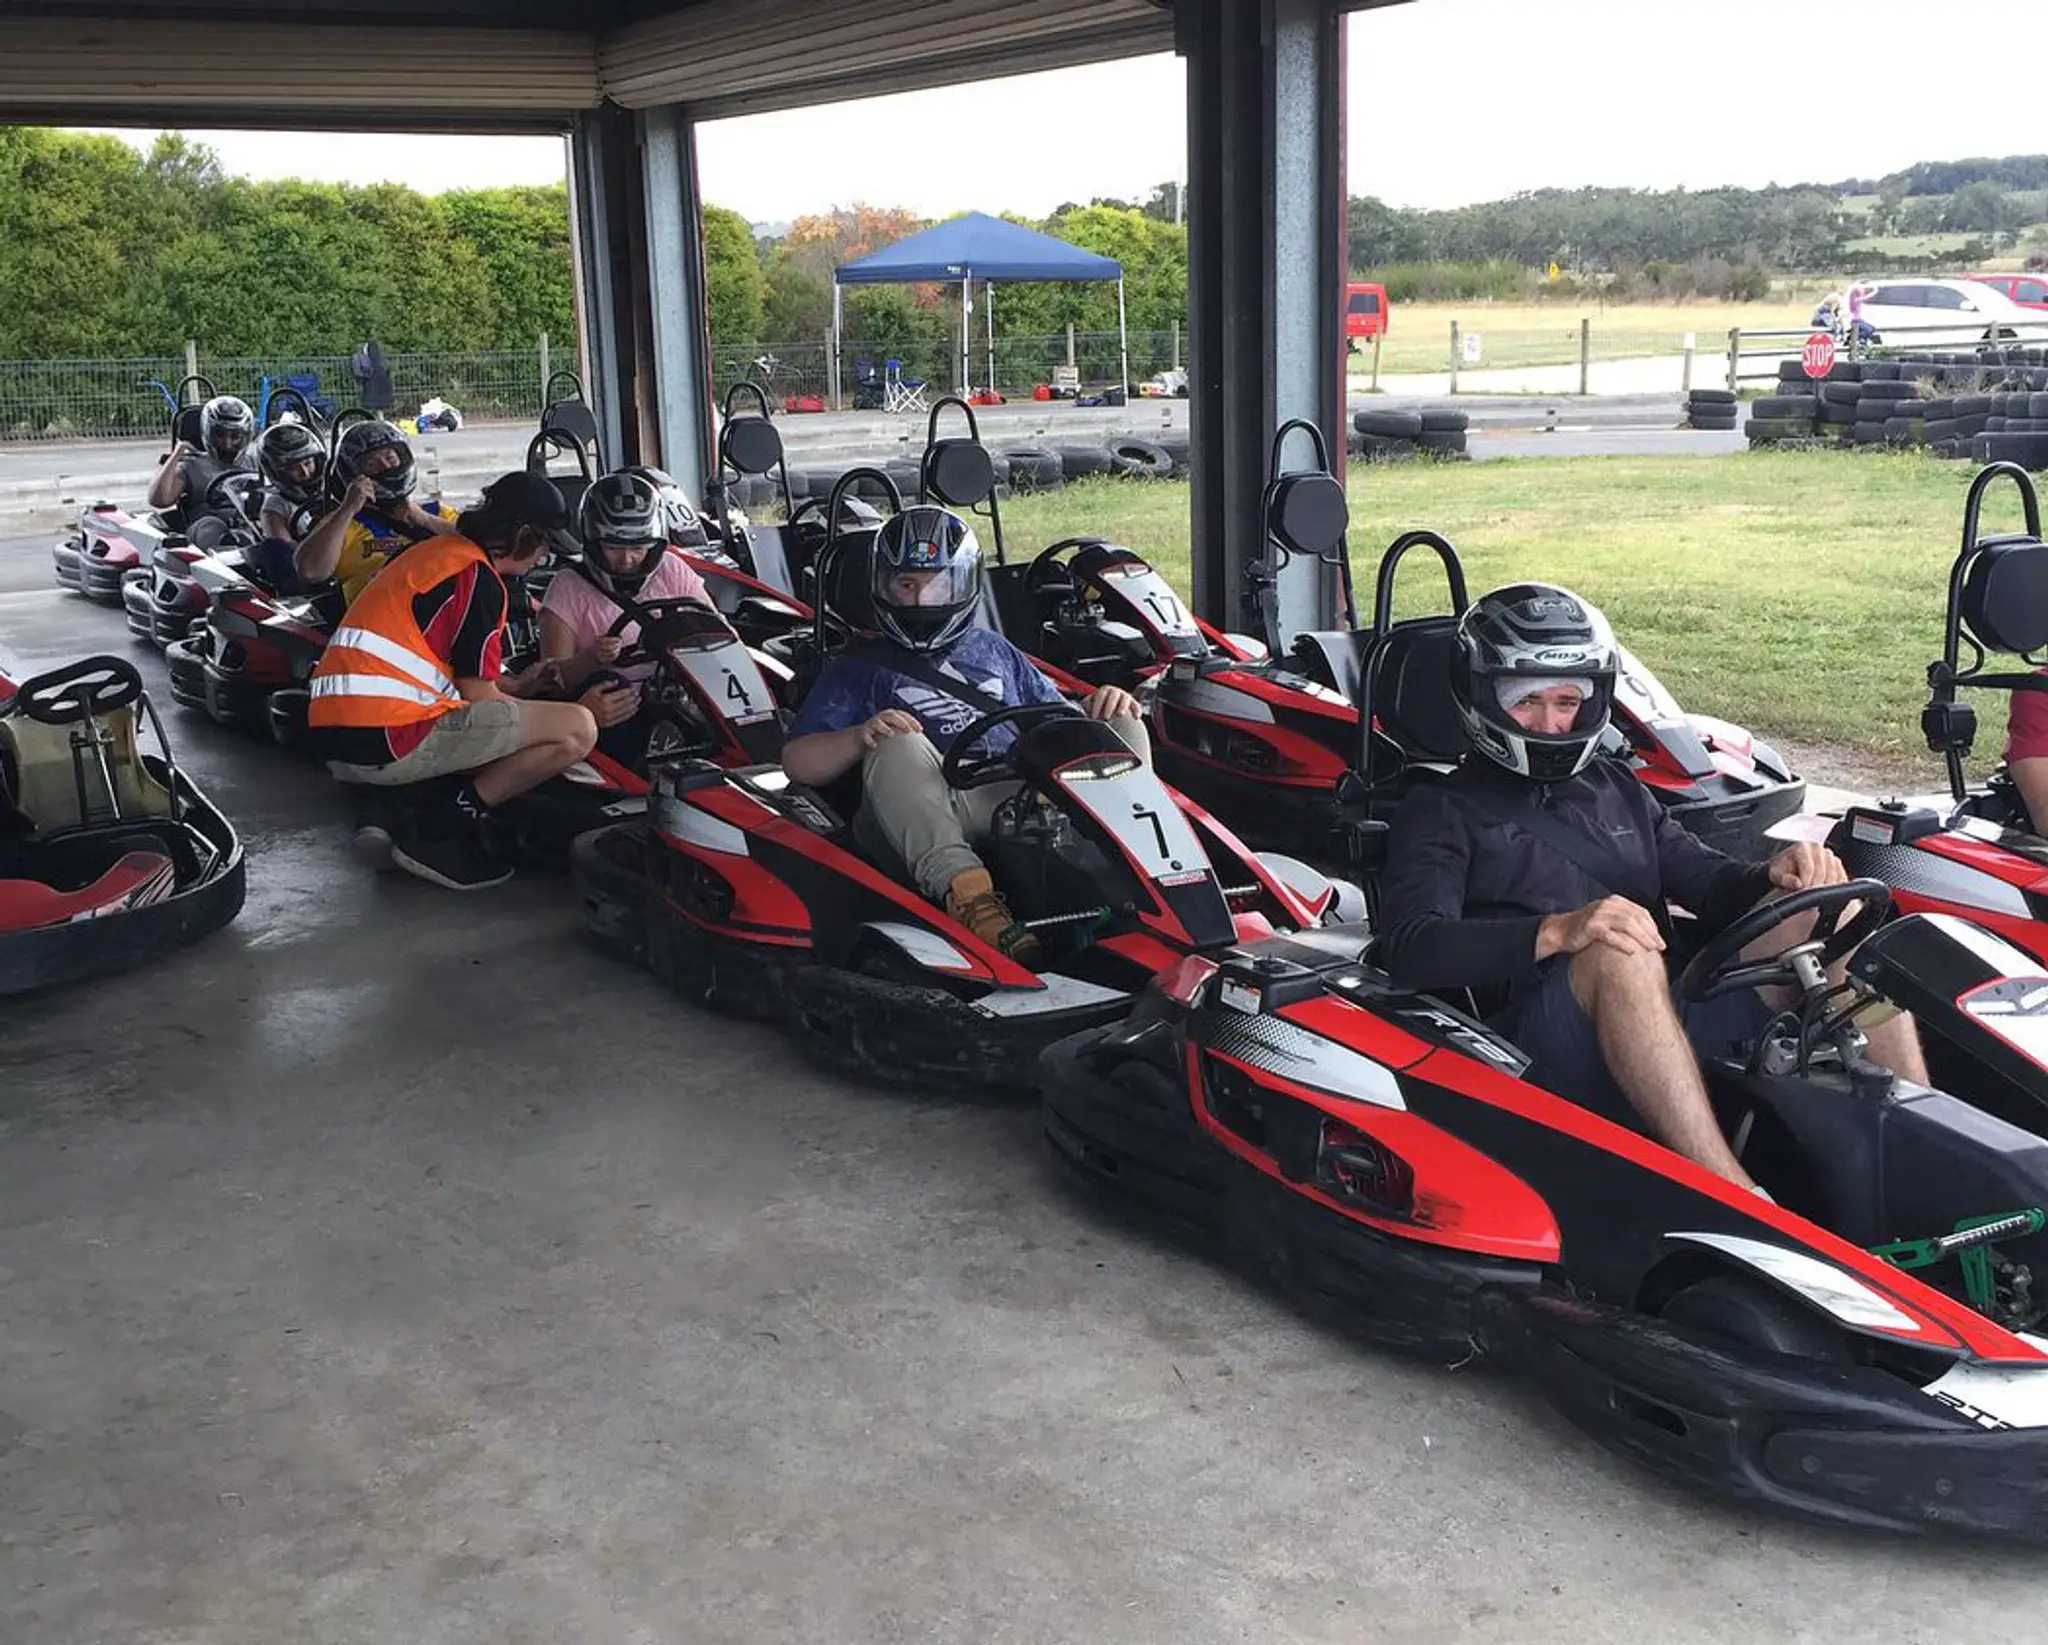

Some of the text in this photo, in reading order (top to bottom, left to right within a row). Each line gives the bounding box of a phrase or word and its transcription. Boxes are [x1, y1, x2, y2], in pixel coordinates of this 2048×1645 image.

[1802, 344, 1834, 367] STOP
[665, 503, 694, 523] 10
[1143, 595, 1182, 625] 17
[727, 673, 751, 706] 4
[1625, 675, 1657, 711] 9
[1133, 811, 1170, 859] 7
